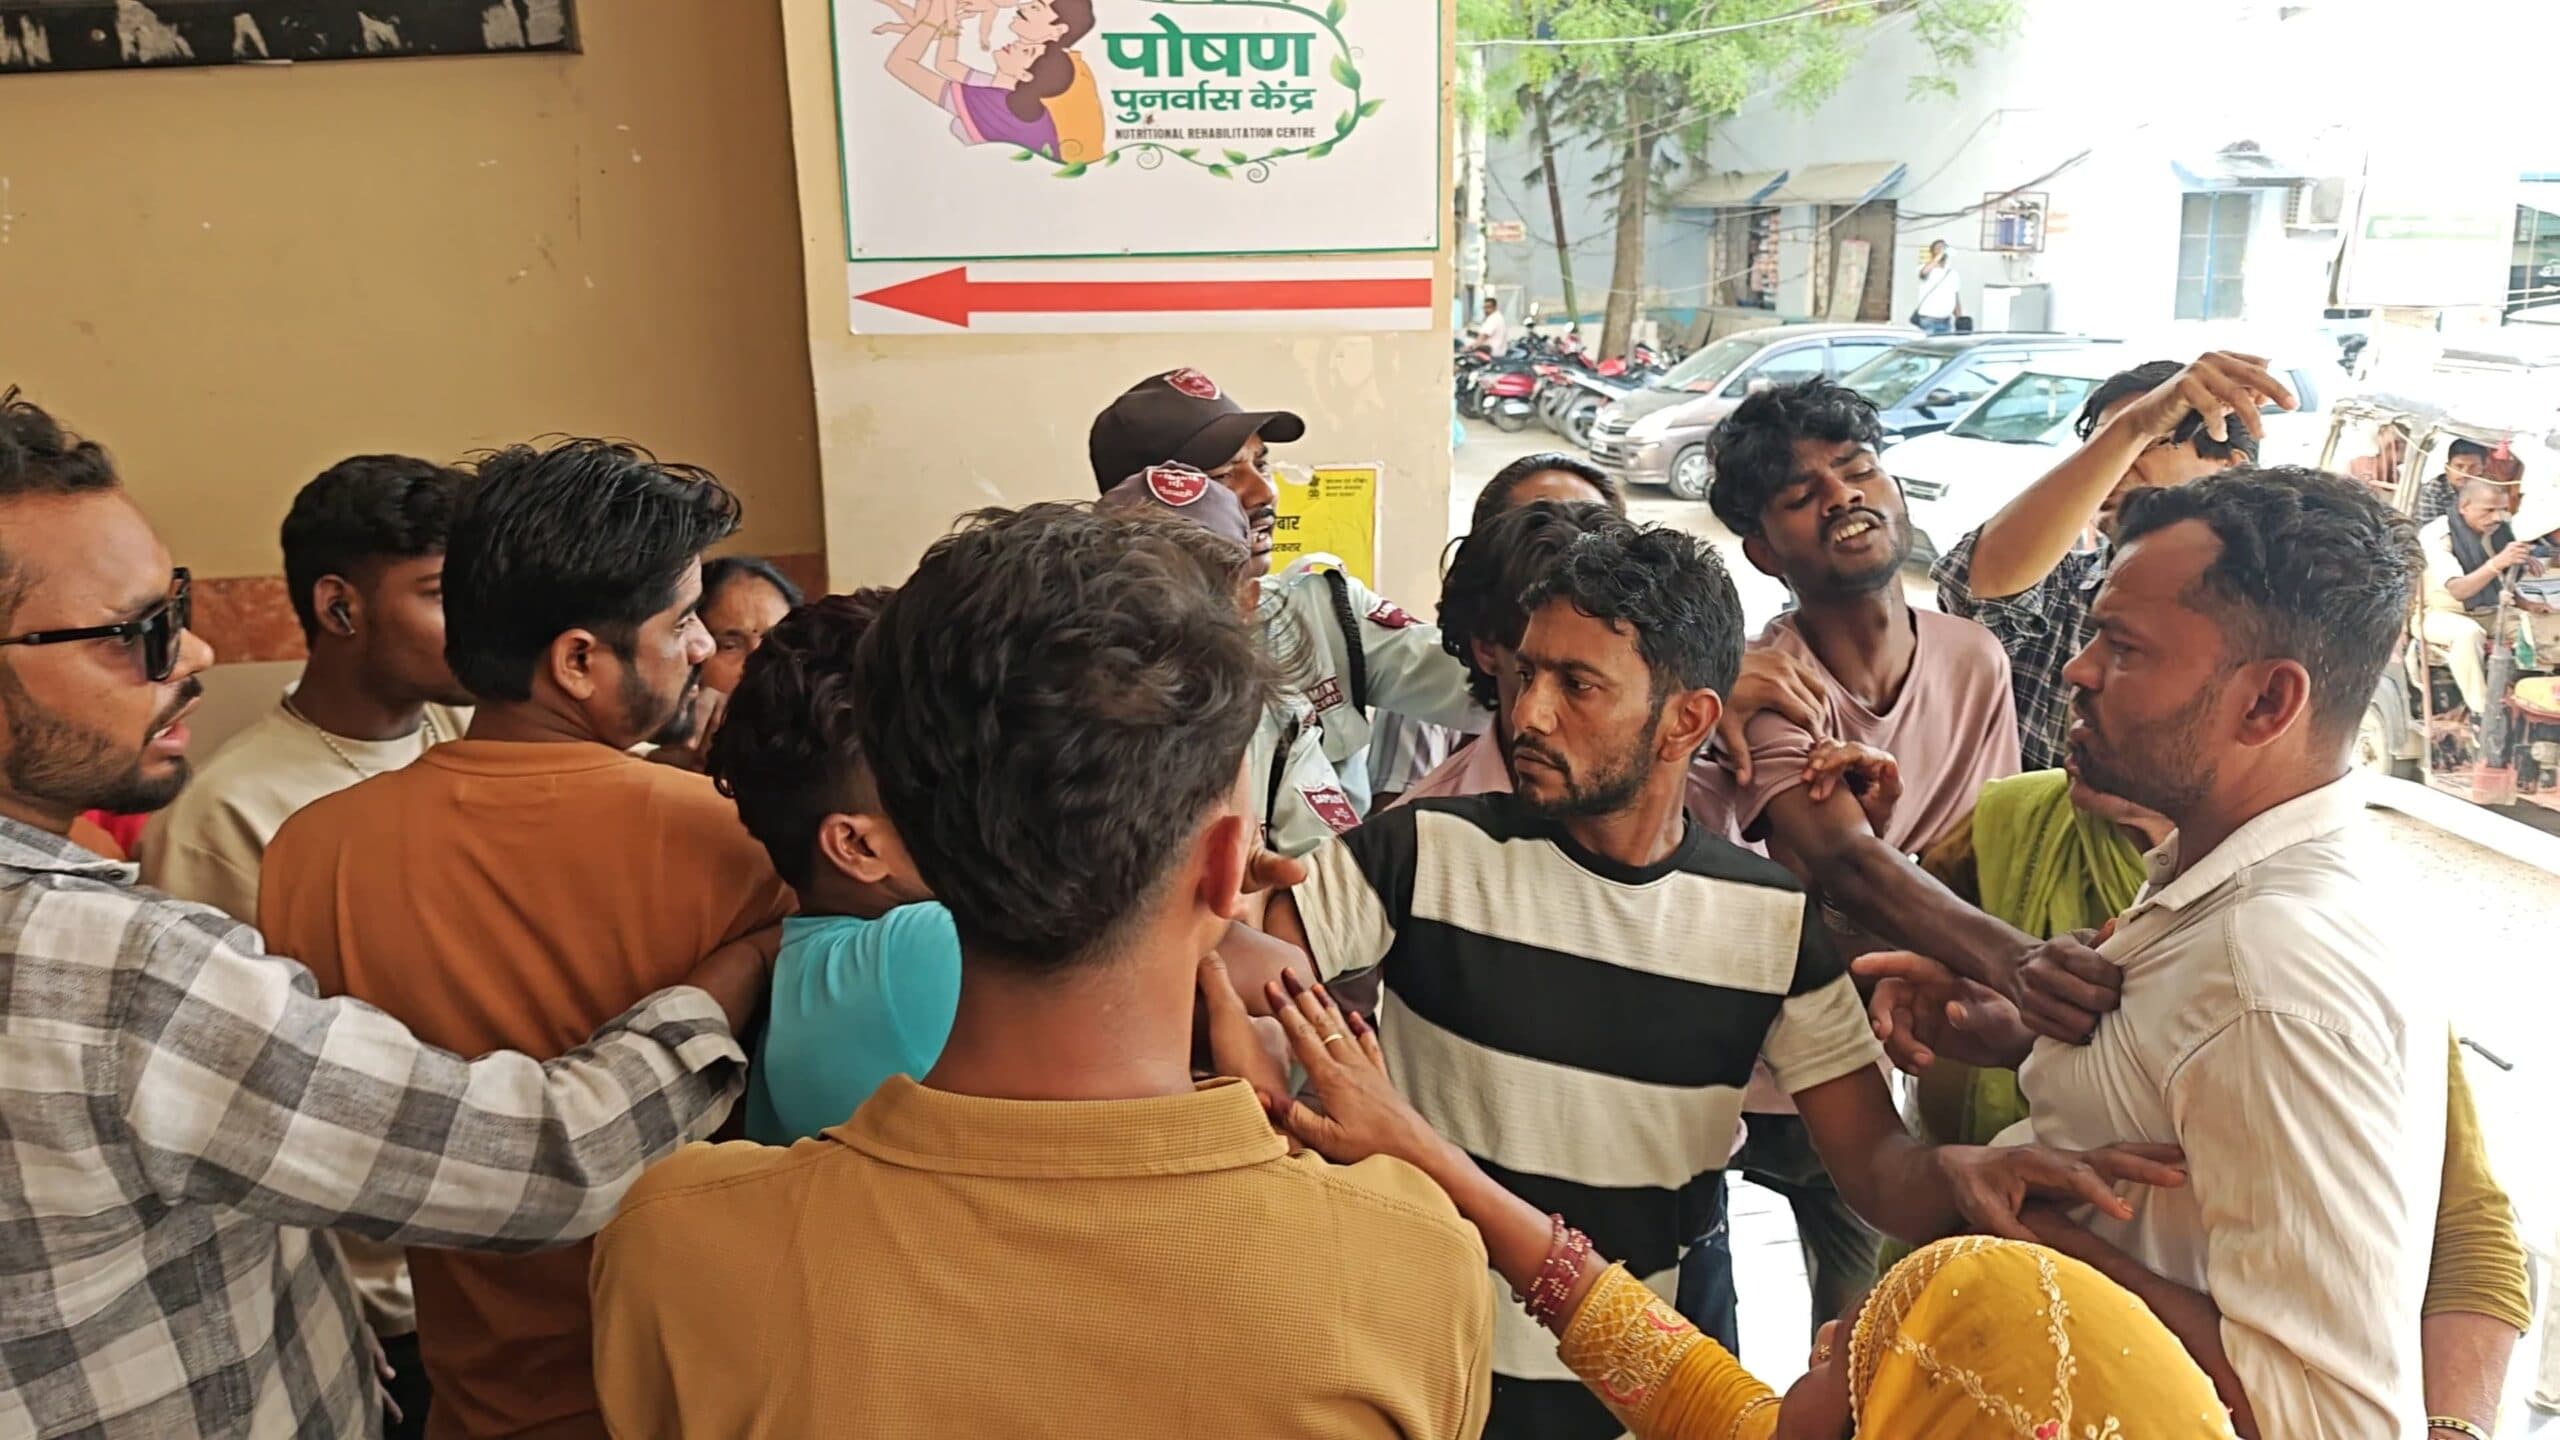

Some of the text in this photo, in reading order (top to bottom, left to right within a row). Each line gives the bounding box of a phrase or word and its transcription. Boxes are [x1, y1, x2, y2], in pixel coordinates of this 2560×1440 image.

[1101, 13, 1316, 77] पोषण
[1111, 80, 1317, 124] पुनर्वास केंद्र
[1115, 127, 1316, 140] NUTRITIONAL REHABILITATION CENTRE
